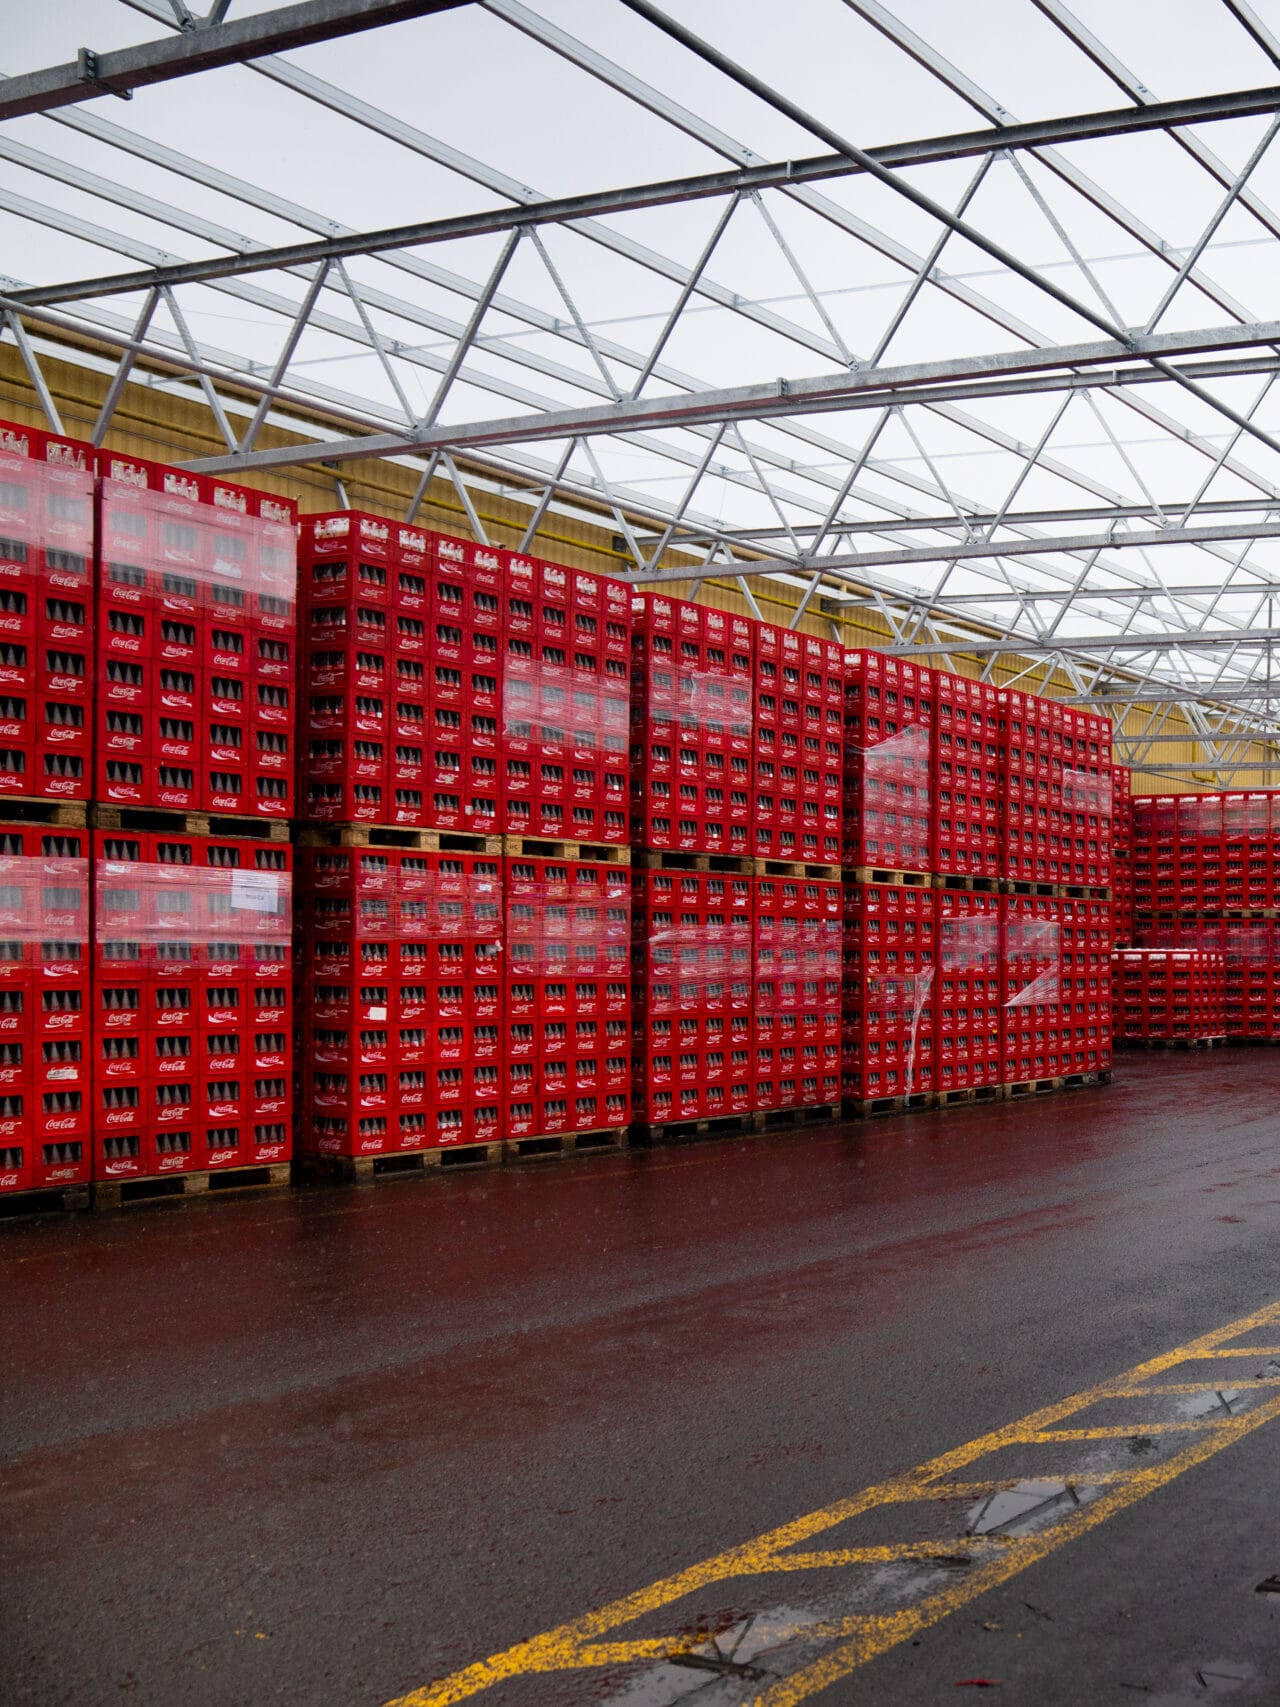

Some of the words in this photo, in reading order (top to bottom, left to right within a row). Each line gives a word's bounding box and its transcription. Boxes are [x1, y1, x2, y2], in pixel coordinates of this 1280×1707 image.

[50, 574, 79, 588] Coca-Cola
[113, 588, 141, 601] Coca-Cola
[261, 616, 285, 628] Coca-Cola
[111, 637, 139, 650] Coca-Cola
[214, 655, 239, 667] Coca-Cola
[162, 744, 189, 756] Coca-Cola
[161, 792, 188, 803] Coca-Cola
[212, 797, 237, 807] Coca-Cola
[159, 1061, 186, 1071] Coca-Cola
[210, 1059, 235, 1069] Coca-Cola
[106, 1112, 134, 1123] Coca-Cola
[46, 1118, 76, 1130] Coca-Cola
